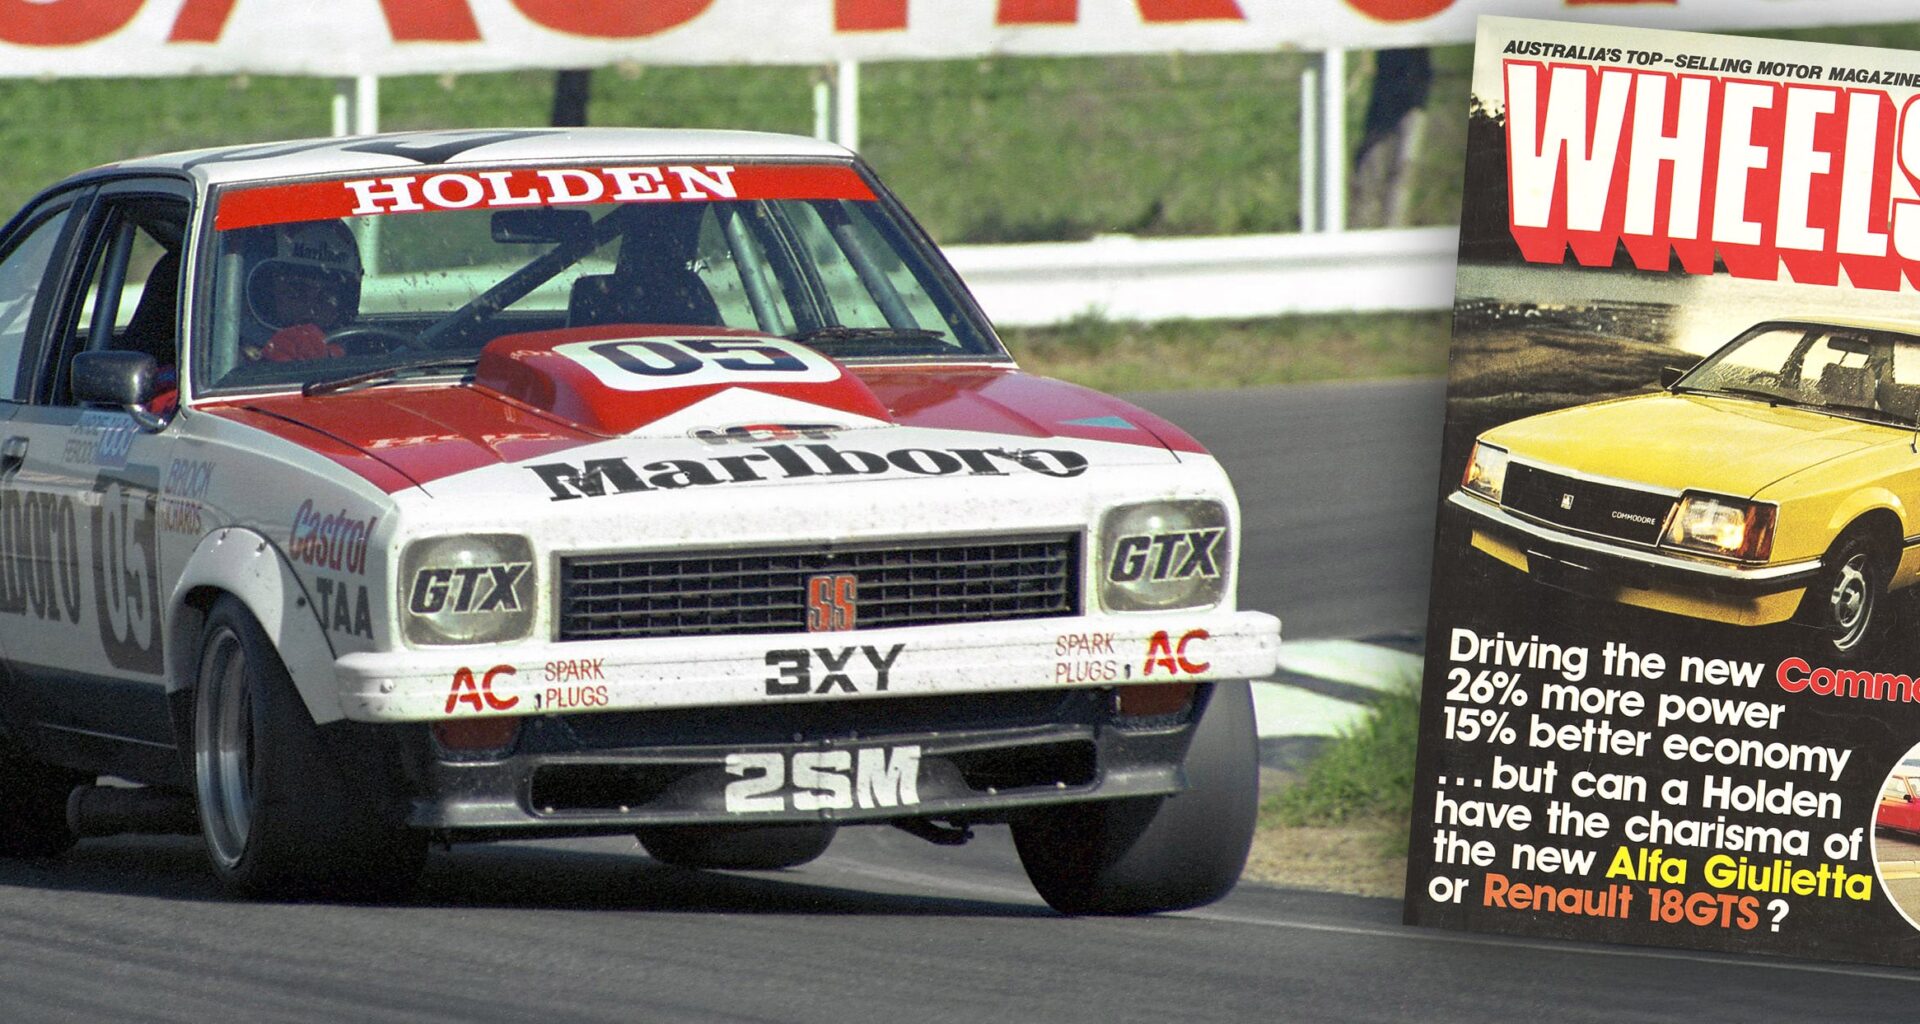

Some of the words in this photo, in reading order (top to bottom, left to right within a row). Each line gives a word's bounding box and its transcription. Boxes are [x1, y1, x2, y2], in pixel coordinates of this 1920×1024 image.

[344, 165, 738, 215] HOLDEN
[587, 338, 809, 377] 05
[524, 443, 1088, 502] Marlboro
[0, 487, 81, 625] boro
[289, 499, 378, 577] Castrol
[1107, 527, 1227, 584] GTX
[101, 482, 152, 652] 05
[408, 562, 533, 617] GTX
[316, 576, 375, 641] TAA
[808, 574, 858, 633] SS
[544, 657, 606, 683] SPARK
[765, 643, 907, 696] 3XY
[1055, 632, 1116, 657] SPARK
[1143, 628, 1212, 677] AC
[444, 664, 520, 715] AC
[545, 685, 609, 709] PLUGS
[1055, 660, 1118, 684] PLUGS
[724, 745, 922, 813] 2SM
